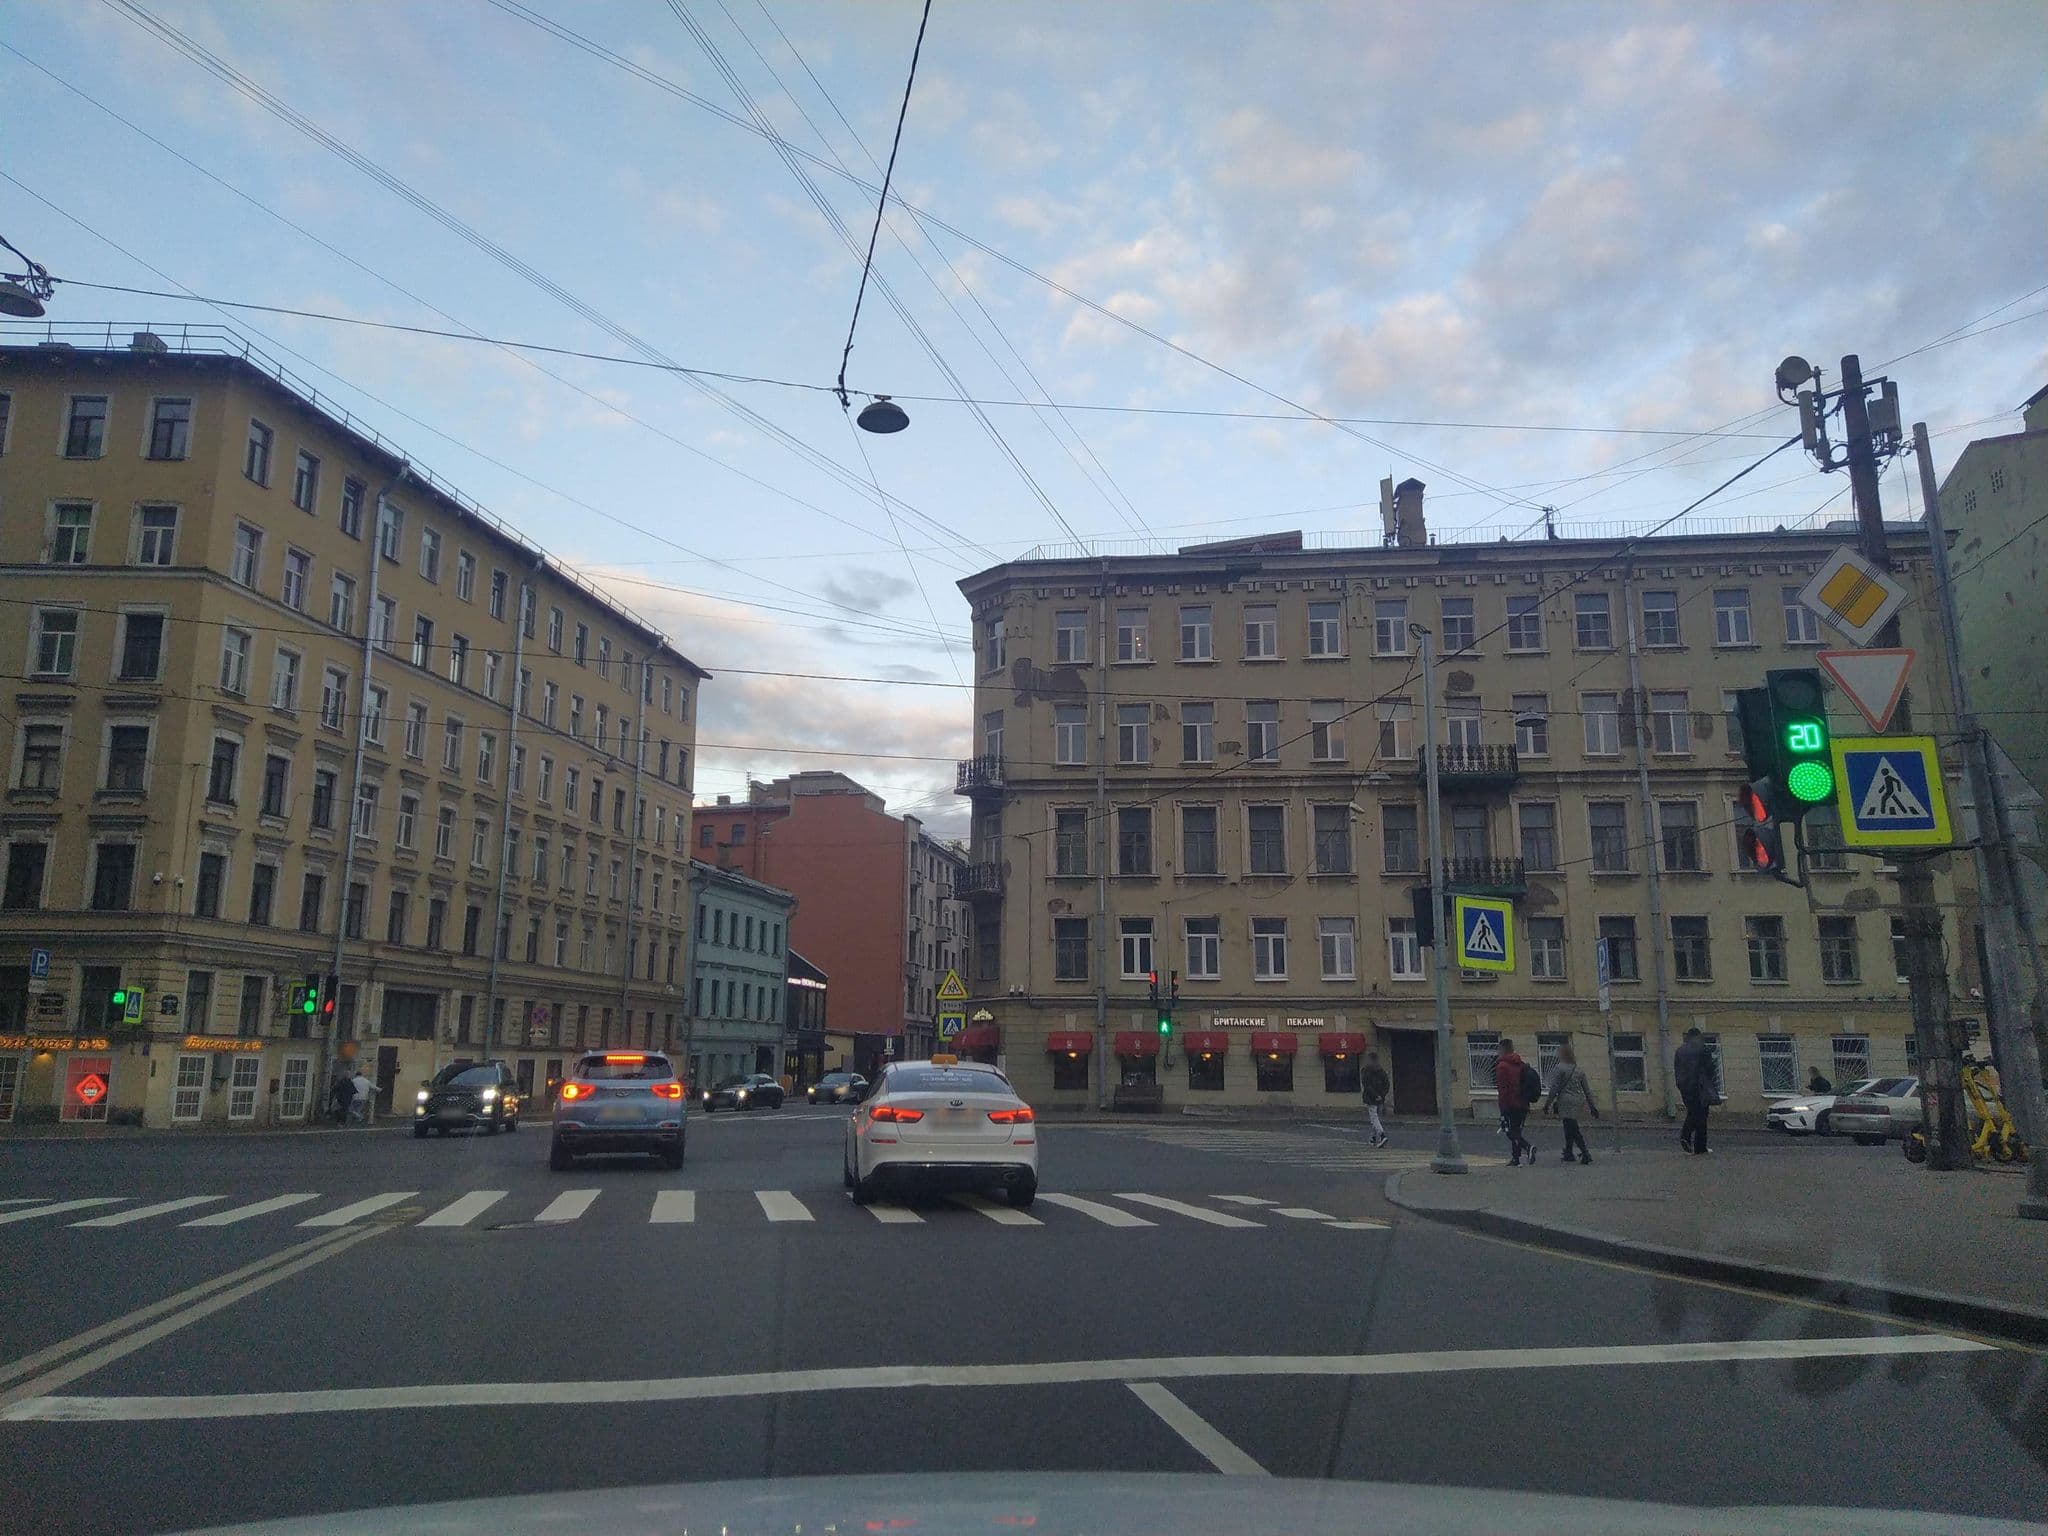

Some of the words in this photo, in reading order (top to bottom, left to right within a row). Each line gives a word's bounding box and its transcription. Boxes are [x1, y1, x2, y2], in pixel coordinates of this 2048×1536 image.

[1788, 723, 1821, 750] 20
[1213, 1017, 1266, 1027] БРИТАНСКИЕ
[1286, 1017, 1325, 1027] ПЕКАРНИ
